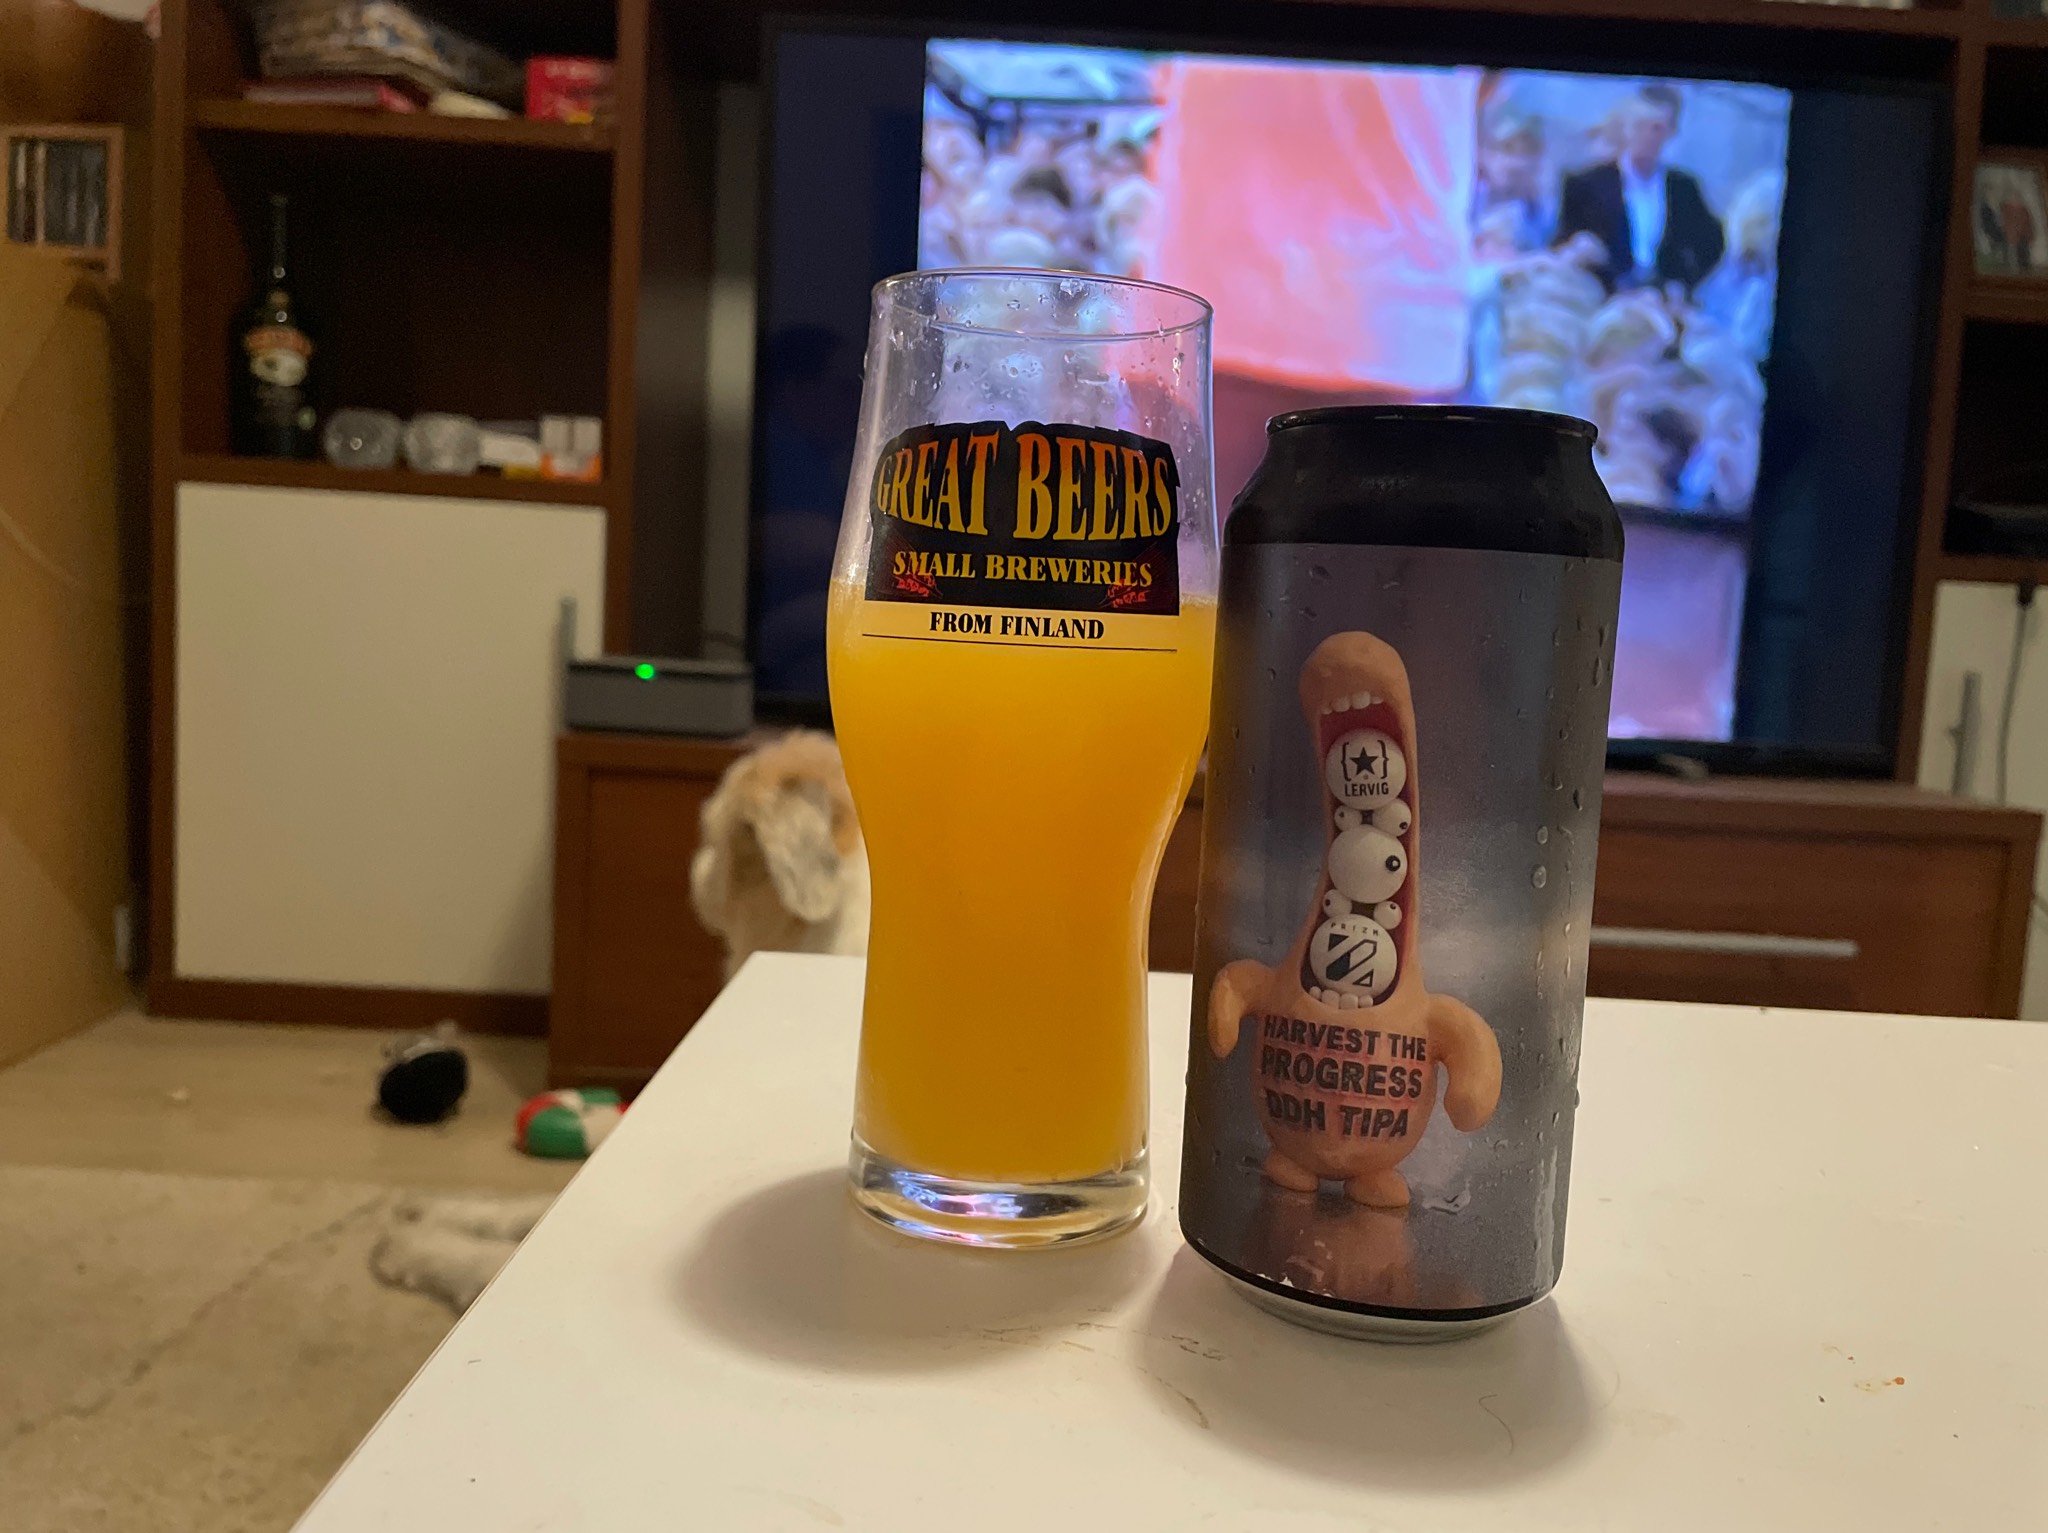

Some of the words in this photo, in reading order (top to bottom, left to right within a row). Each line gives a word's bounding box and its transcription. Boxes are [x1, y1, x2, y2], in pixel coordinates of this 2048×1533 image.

[877, 428, 1000, 537] GREAT
[1013, 432, 1172, 541] BEERS
[892, 551, 976, 579] SMALL
[985, 555, 1153, 587] BREWERIES
[929, 611, 992, 635] FROM
[1001, 615, 1105, 640] FINLAND
[1344, 781, 1390, 797] LERVIG
[1330, 922, 1380, 937] PRIZM
[1263, 1014, 1381, 1056] HARVEST
[1388, 1033, 1427, 1062] THE
[1261, 1045, 1423, 1099] PROGRESS
[1265, 1089, 1326, 1131] DDH
[1340, 1105, 1409, 1138] TIPA
